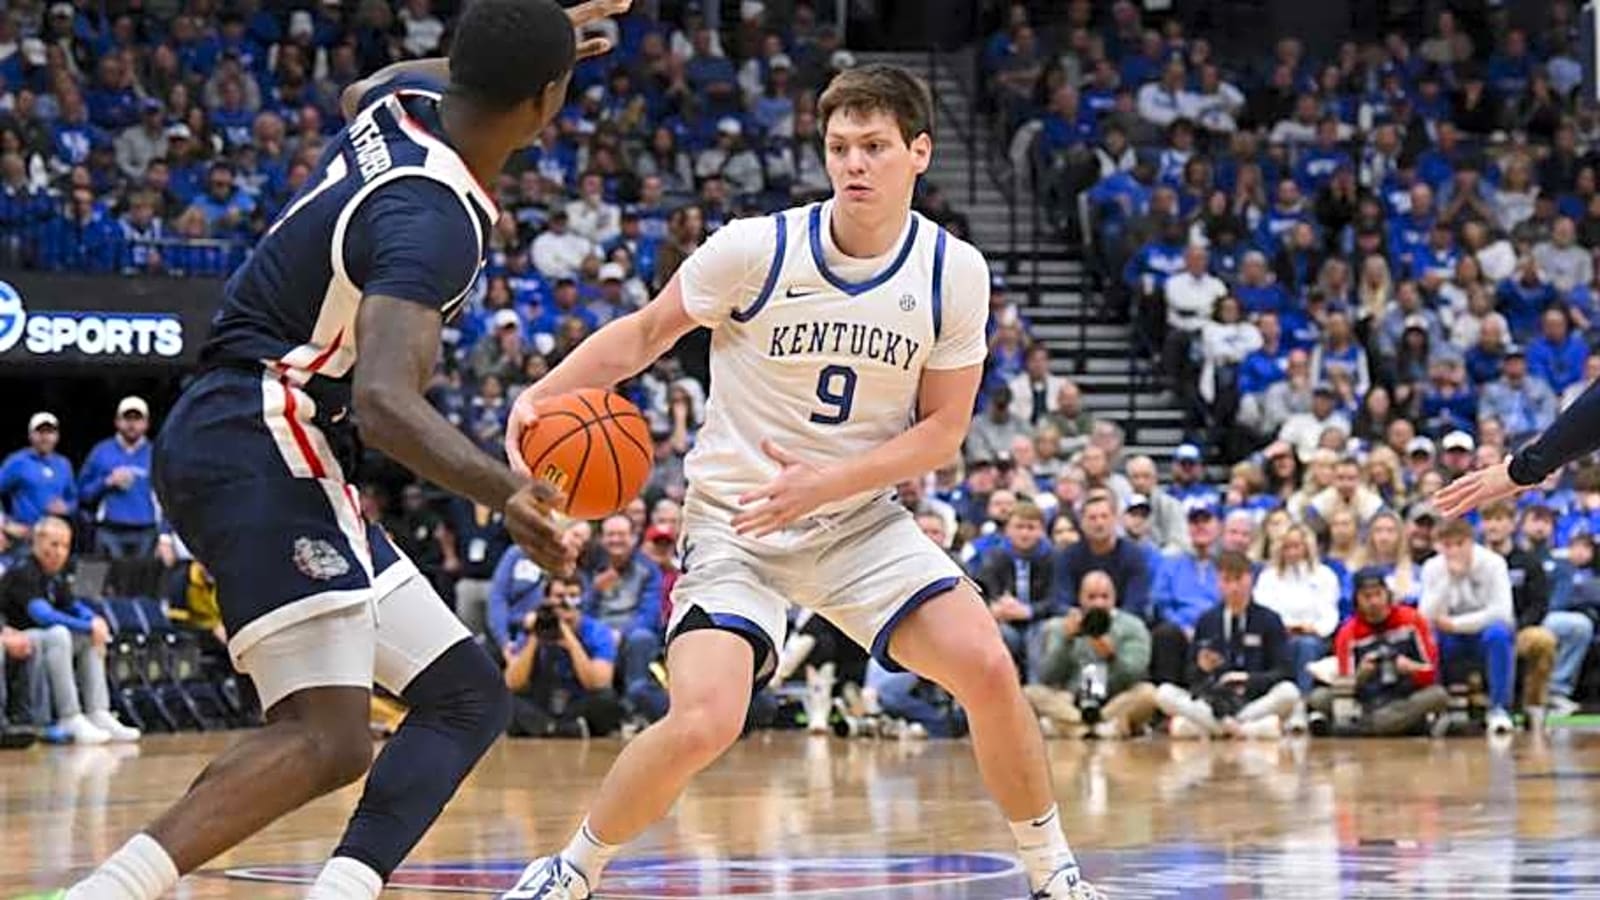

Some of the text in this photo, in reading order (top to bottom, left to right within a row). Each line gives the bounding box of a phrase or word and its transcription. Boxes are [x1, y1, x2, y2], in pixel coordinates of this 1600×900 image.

[26, 315, 183, 356] SPORTS
[769, 321, 919, 370] KENTUCKY
[810, 364, 858, 425] 9
